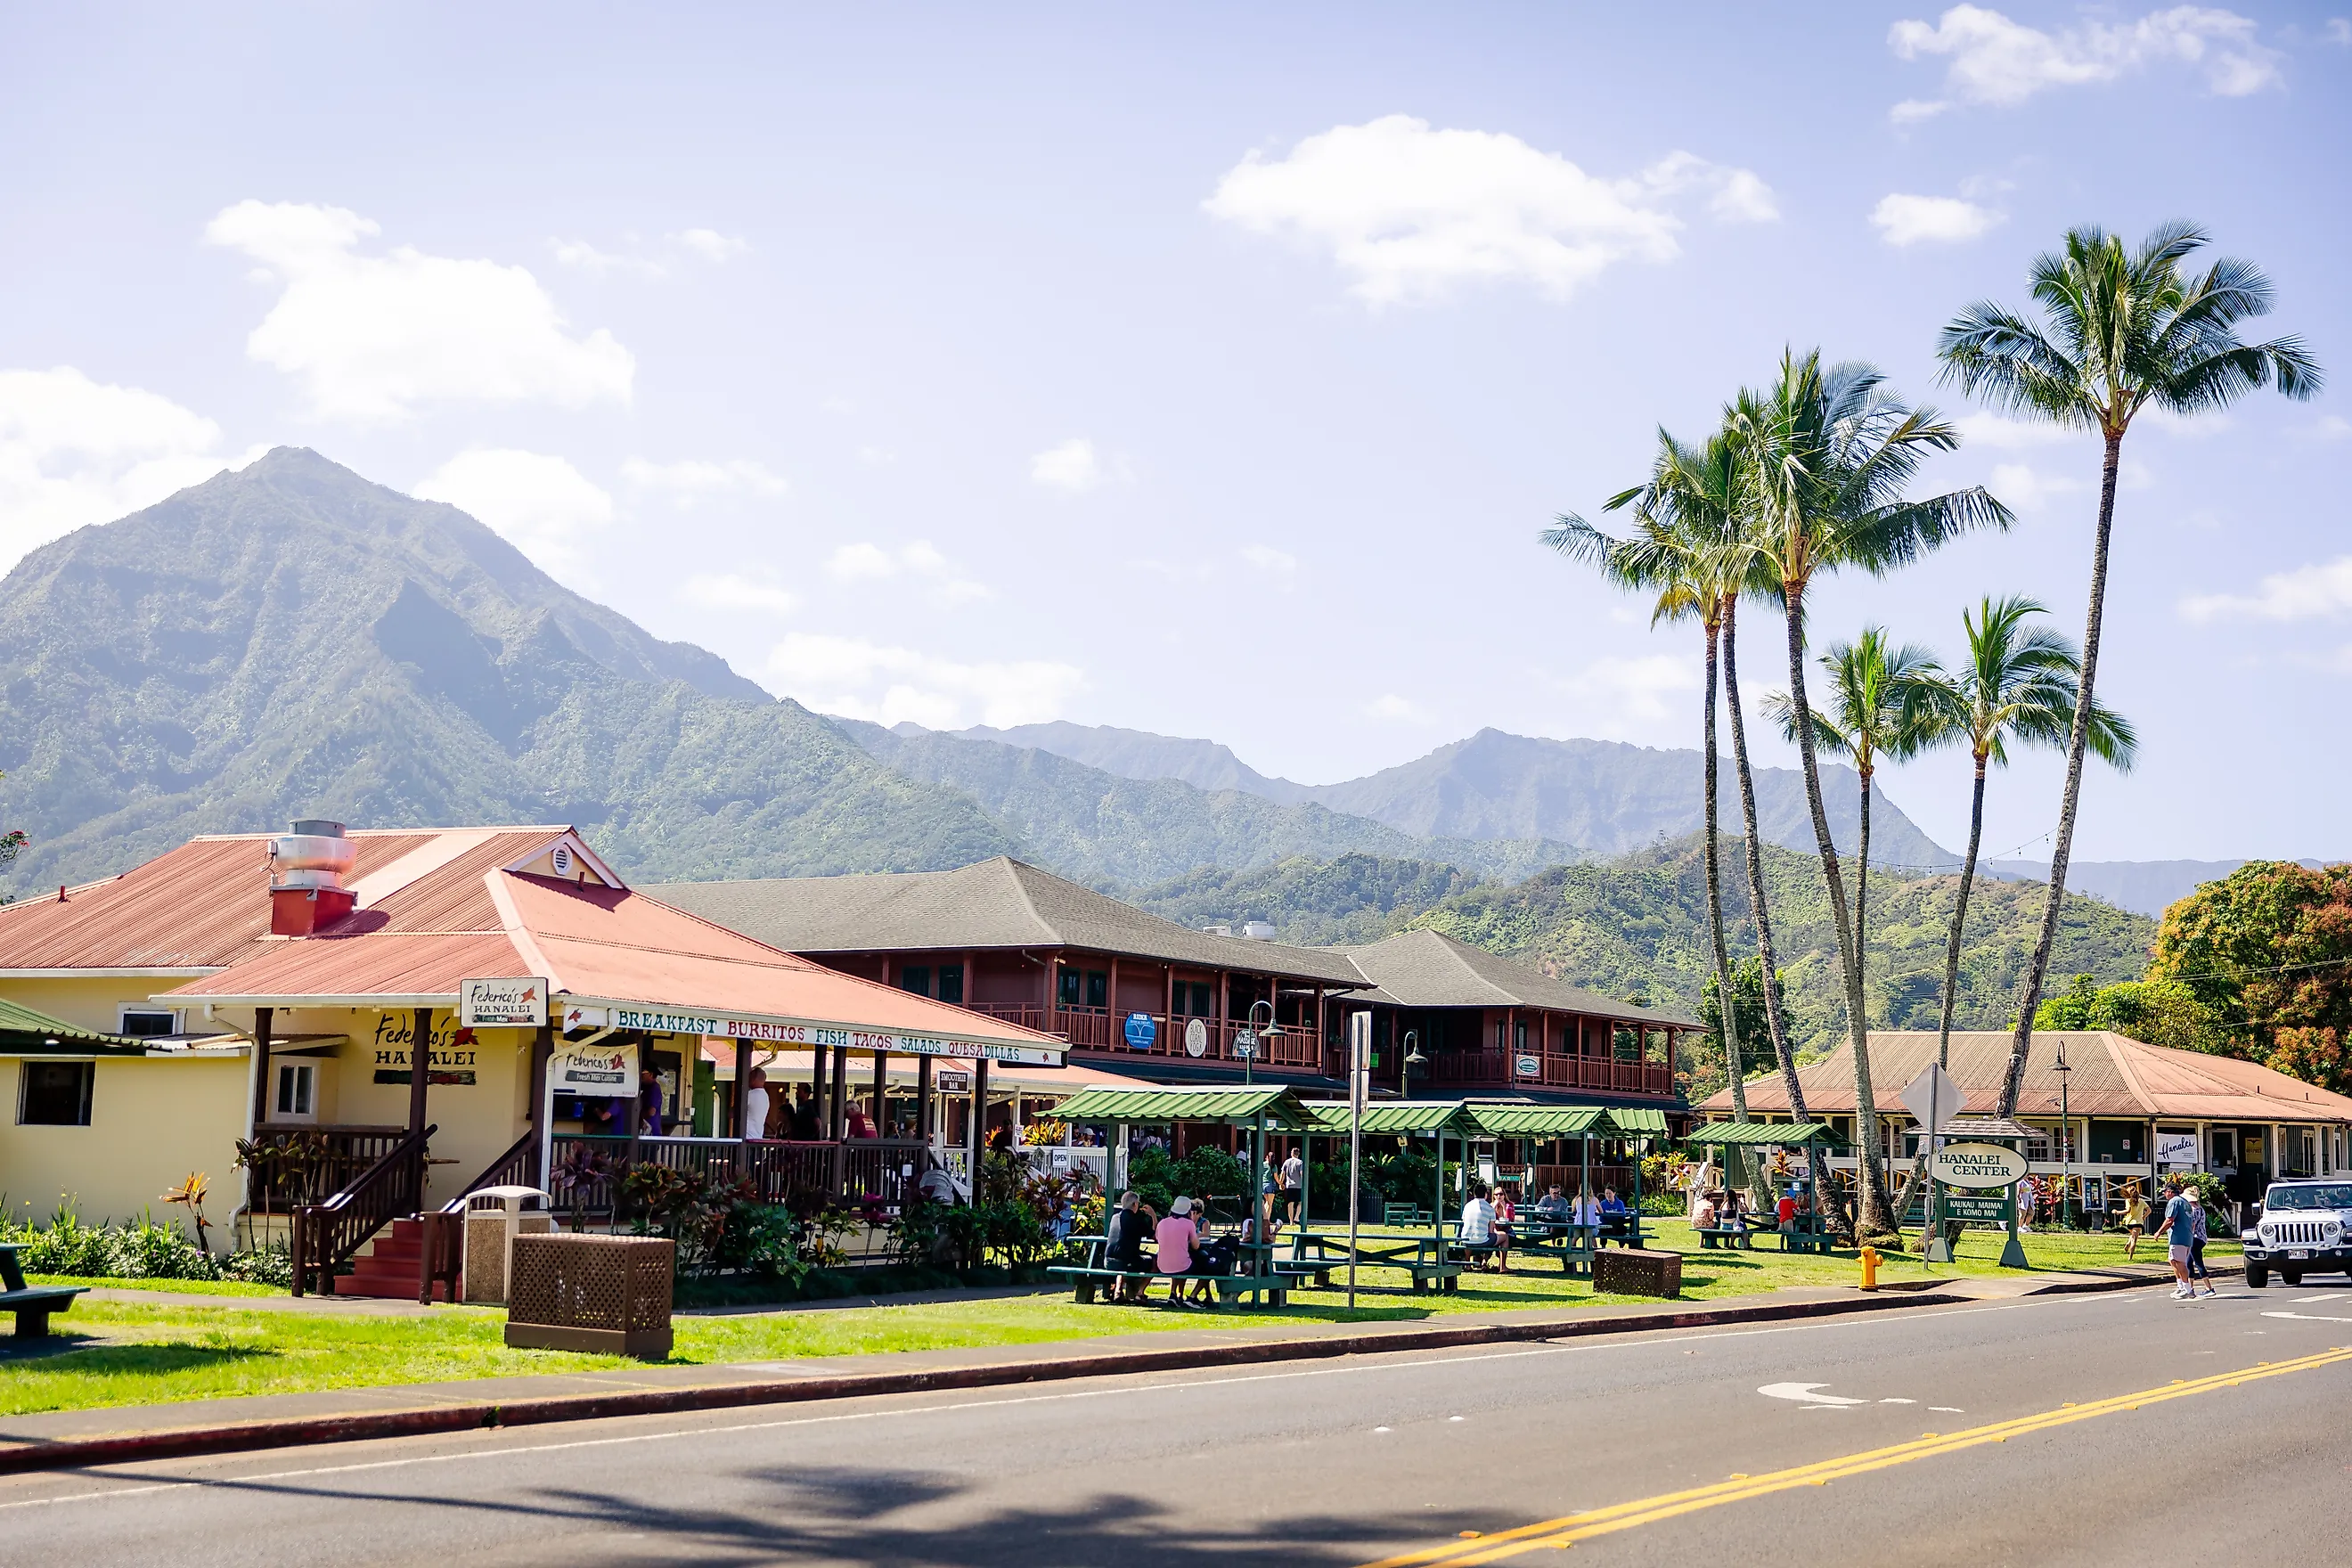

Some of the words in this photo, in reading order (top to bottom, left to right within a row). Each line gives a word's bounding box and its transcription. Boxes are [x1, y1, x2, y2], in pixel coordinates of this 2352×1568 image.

[470, 984, 519, 1004] Federico's
[474, 1005, 531, 1013] HANALEI
[1189, 1024, 1202, 1033] BLACK
[618, 1010, 717, 1033] BREAKFAST
[727, 1021, 805, 1041] BURRITOS
[816, 1029, 847, 1045] FISH
[853, 1033, 893, 1049] TACOS
[901, 1037, 941, 1053] SALADS
[948, 1041, 1020, 1060] QUESADILLAS
[1238, 1037, 1255, 1045] MASSGE
[374, 1050, 476, 1065] HAALEI
[941, 1073, 967, 1082] SMOOTHIE
[948, 1082, 959, 1090] BAR
[2158, 1137, 2195, 1160] Hanalei
[1053, 1154, 1067, 1162] OPEN
[1939, 1154, 2001, 1165] HANALEI
[1952, 1165, 2012, 1176] CENTER
[1949, 1200, 1975, 1208] KAUKAU
[1978, 1201, 2003, 1210] MAIMAI
[1984, 1209, 1997, 1217] MAI
